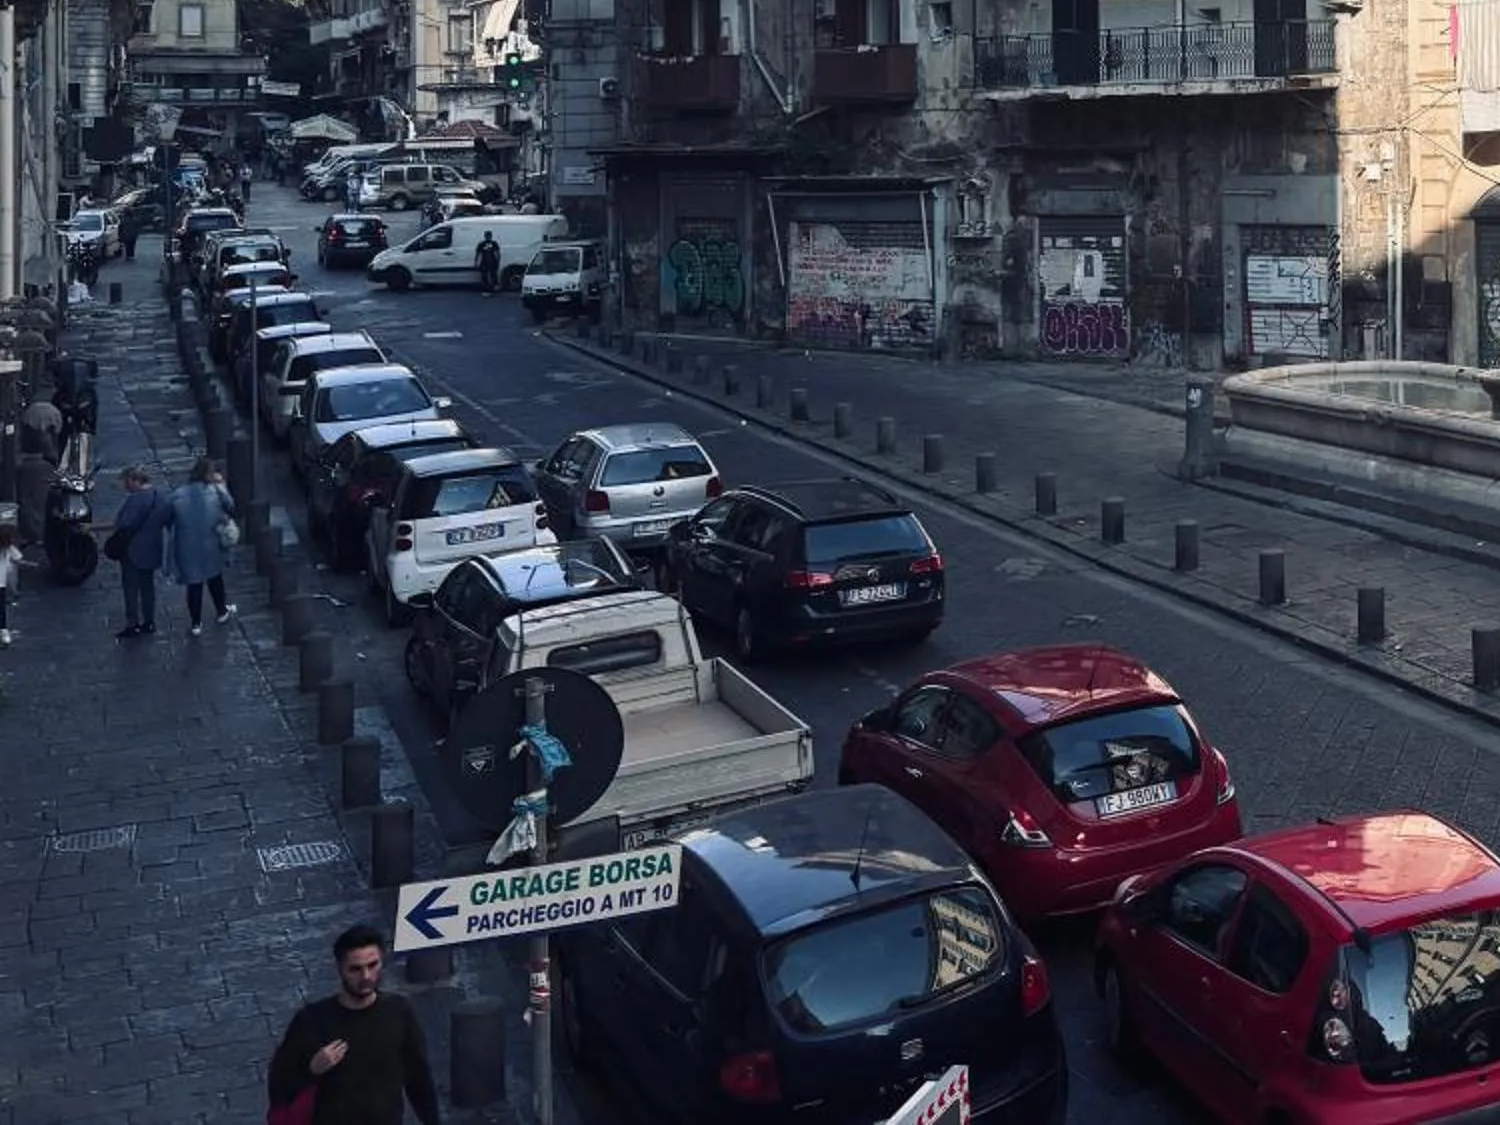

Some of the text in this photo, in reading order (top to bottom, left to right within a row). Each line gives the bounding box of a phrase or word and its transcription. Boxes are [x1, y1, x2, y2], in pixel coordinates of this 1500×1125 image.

[469, 852, 673, 906] GARAGE BORSA
[466, 883, 673, 934] PARCHEGGIO A MT 10
